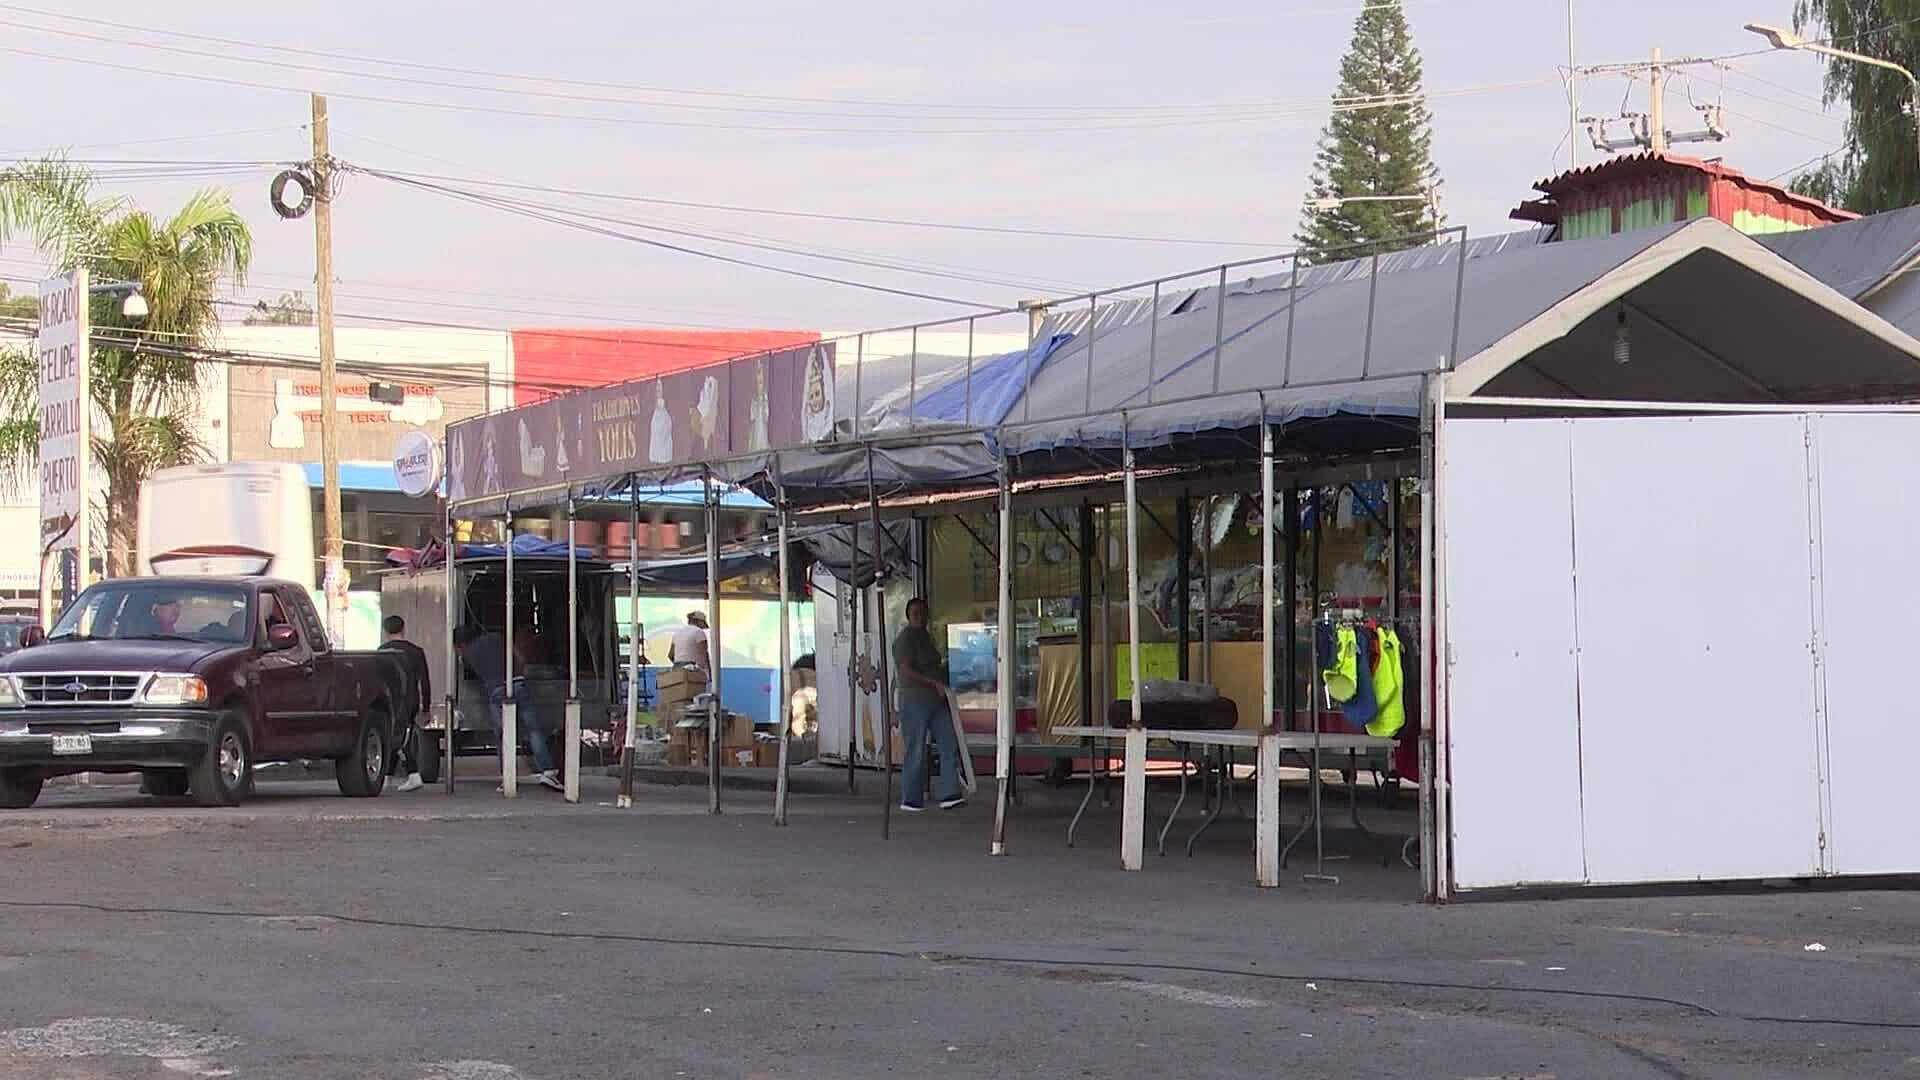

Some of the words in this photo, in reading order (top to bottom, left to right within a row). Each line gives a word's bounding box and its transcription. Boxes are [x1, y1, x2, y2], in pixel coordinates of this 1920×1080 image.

[39, 285, 79, 331] MERCADO
[41, 343, 75, 385] FELIPE
[40, 398, 80, 441] CARRILLO
[597, 421, 637, 463] YOLIS
[42, 456, 77, 497] PUERTO
